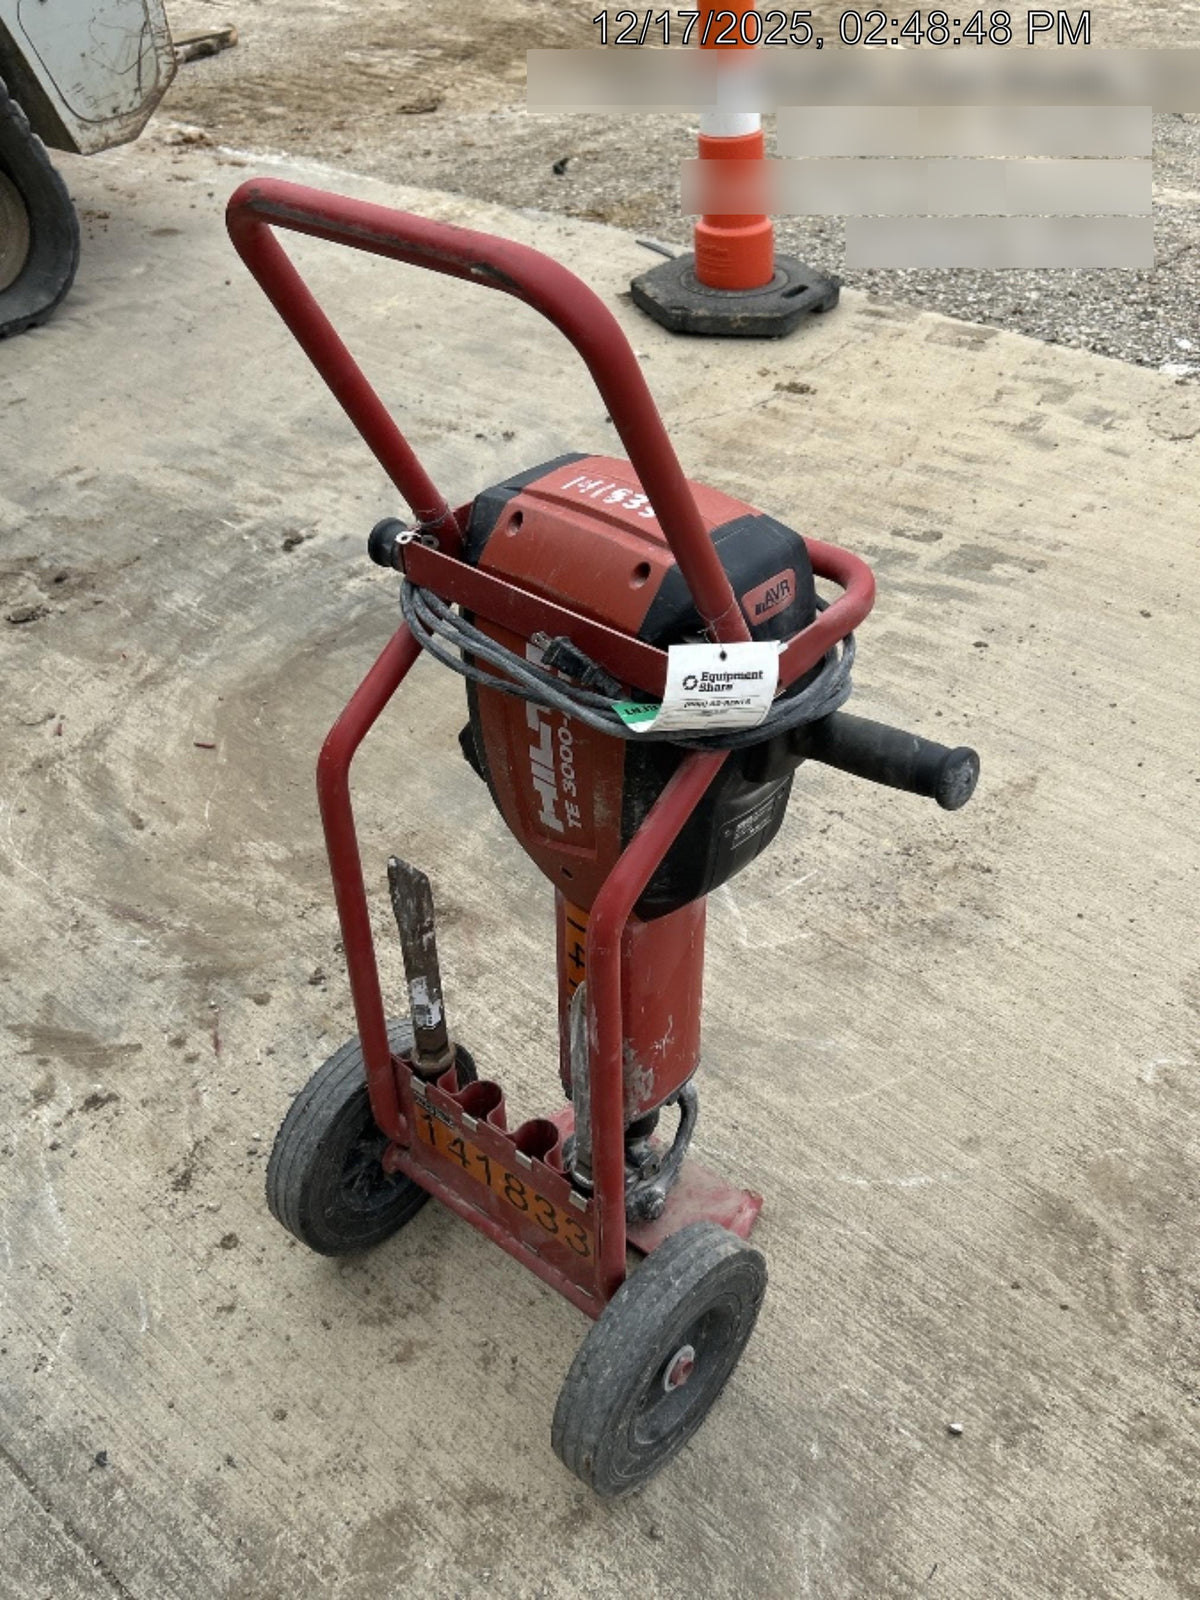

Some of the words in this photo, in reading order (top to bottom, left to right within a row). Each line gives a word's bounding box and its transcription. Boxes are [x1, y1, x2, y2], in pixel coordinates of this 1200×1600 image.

[765, 579, 790, 606] AVR
[698, 683, 733, 692] Share
[701, 670, 763, 683] Equipment
[565, 800, 582, 829] TE
[420, 1112, 592, 1258] 141833
